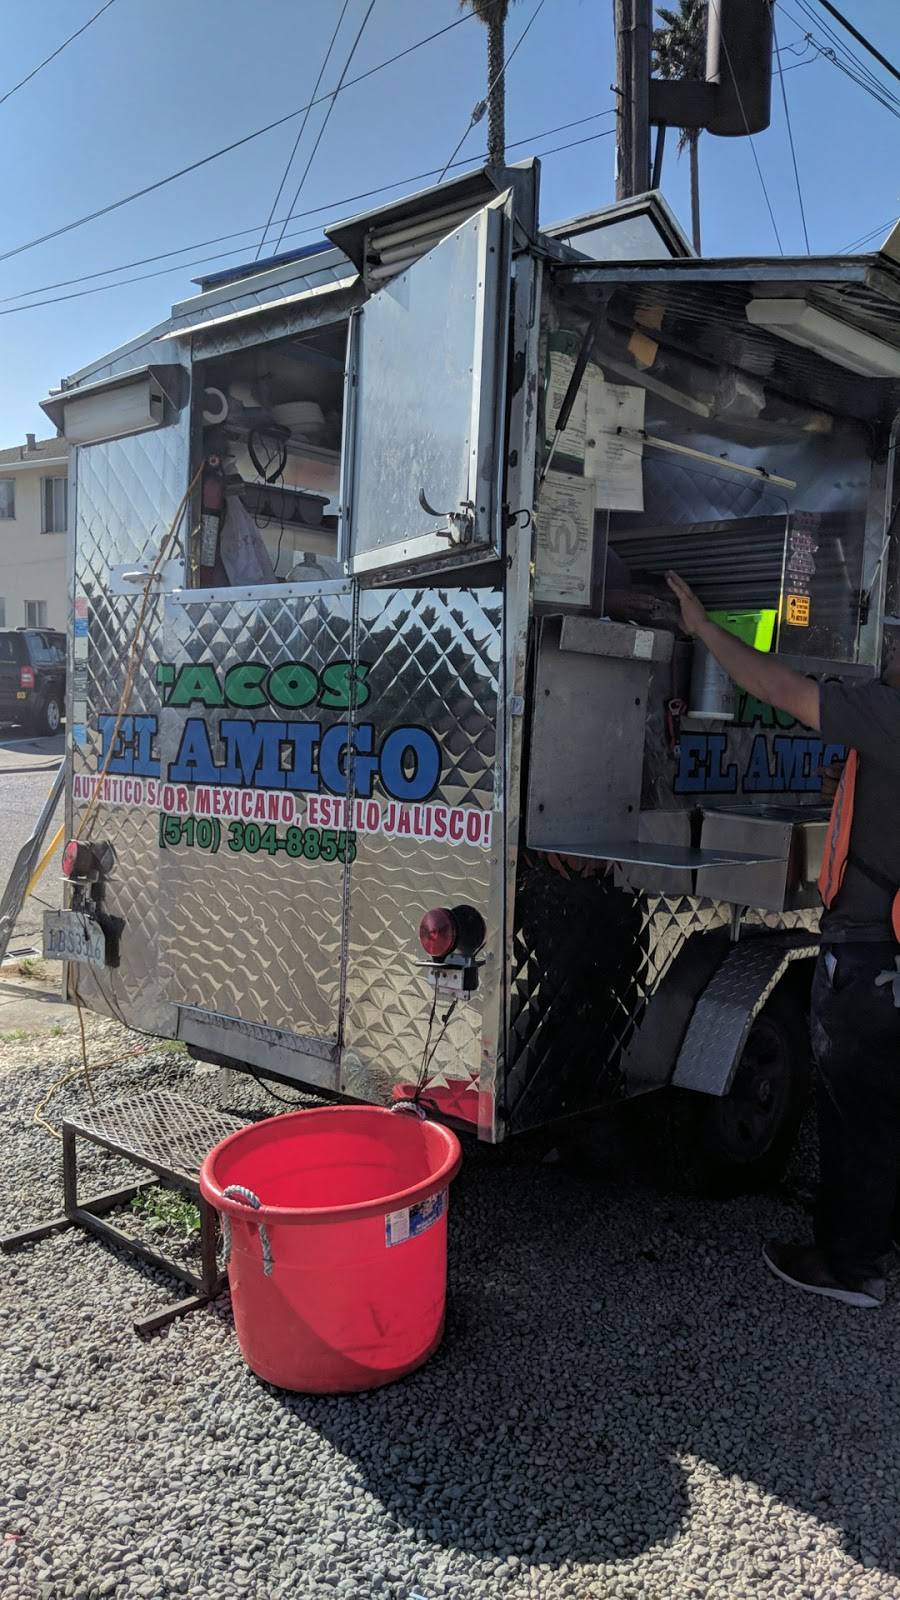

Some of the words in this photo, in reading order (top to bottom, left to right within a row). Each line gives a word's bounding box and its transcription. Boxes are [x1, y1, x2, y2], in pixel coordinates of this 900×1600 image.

[158, 660, 372, 710] TACOS
[98, 713, 161, 778] EL
[168, 717, 443, 802] AMIGO
[673, 731, 738, 795] EL
[159, 812, 221, 854] (510)
[228, 821, 357, 864] 304-8855
[383, 803, 492, 844] JALISCO!
